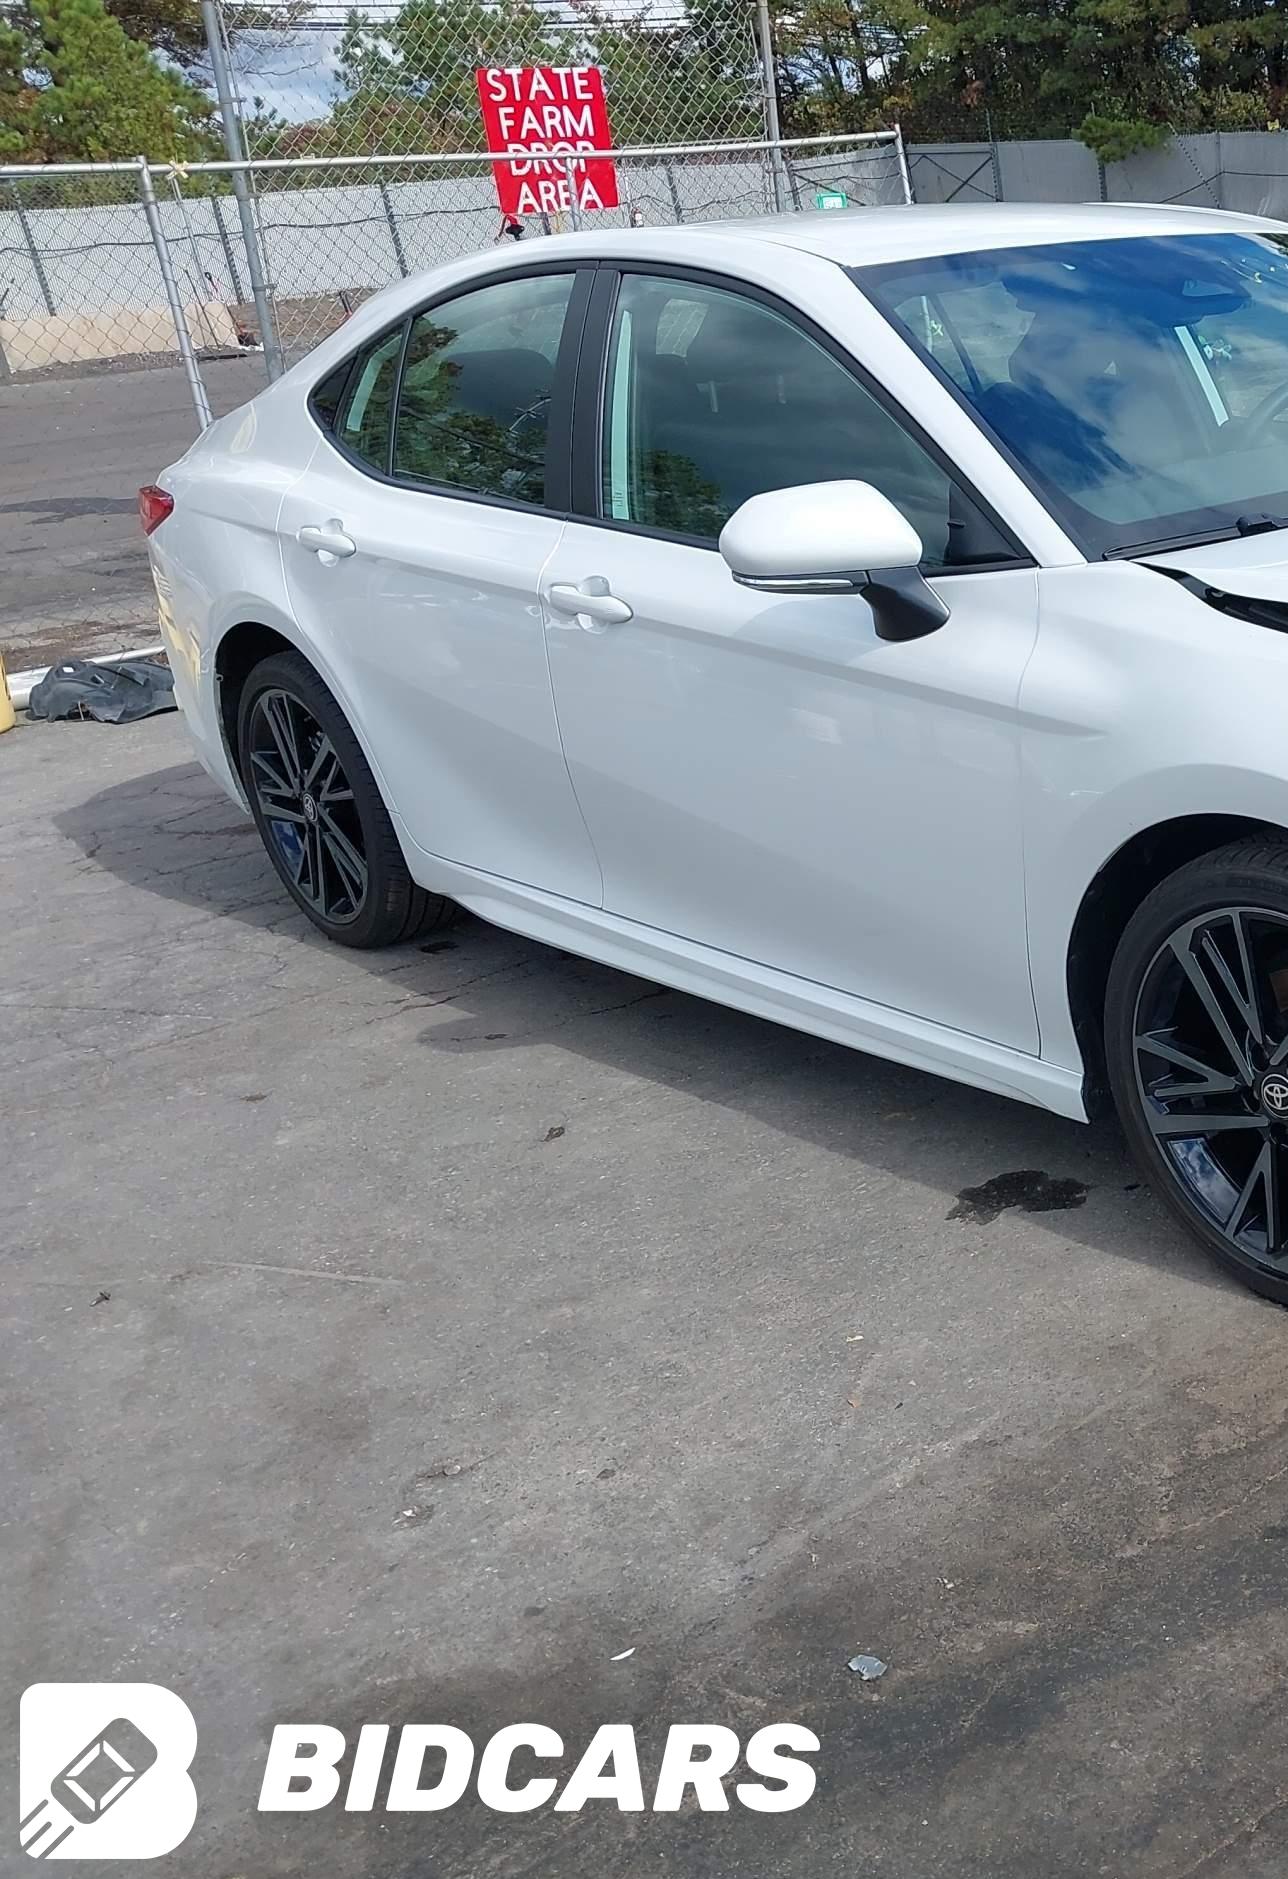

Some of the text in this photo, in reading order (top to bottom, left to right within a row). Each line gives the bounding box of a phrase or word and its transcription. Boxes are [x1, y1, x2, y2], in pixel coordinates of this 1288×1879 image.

[486, 67, 594, 102] STATE
[498, 105, 595, 140] FARM
[507, 141, 595, 176] DROP
[517, 179, 604, 214] AREA
